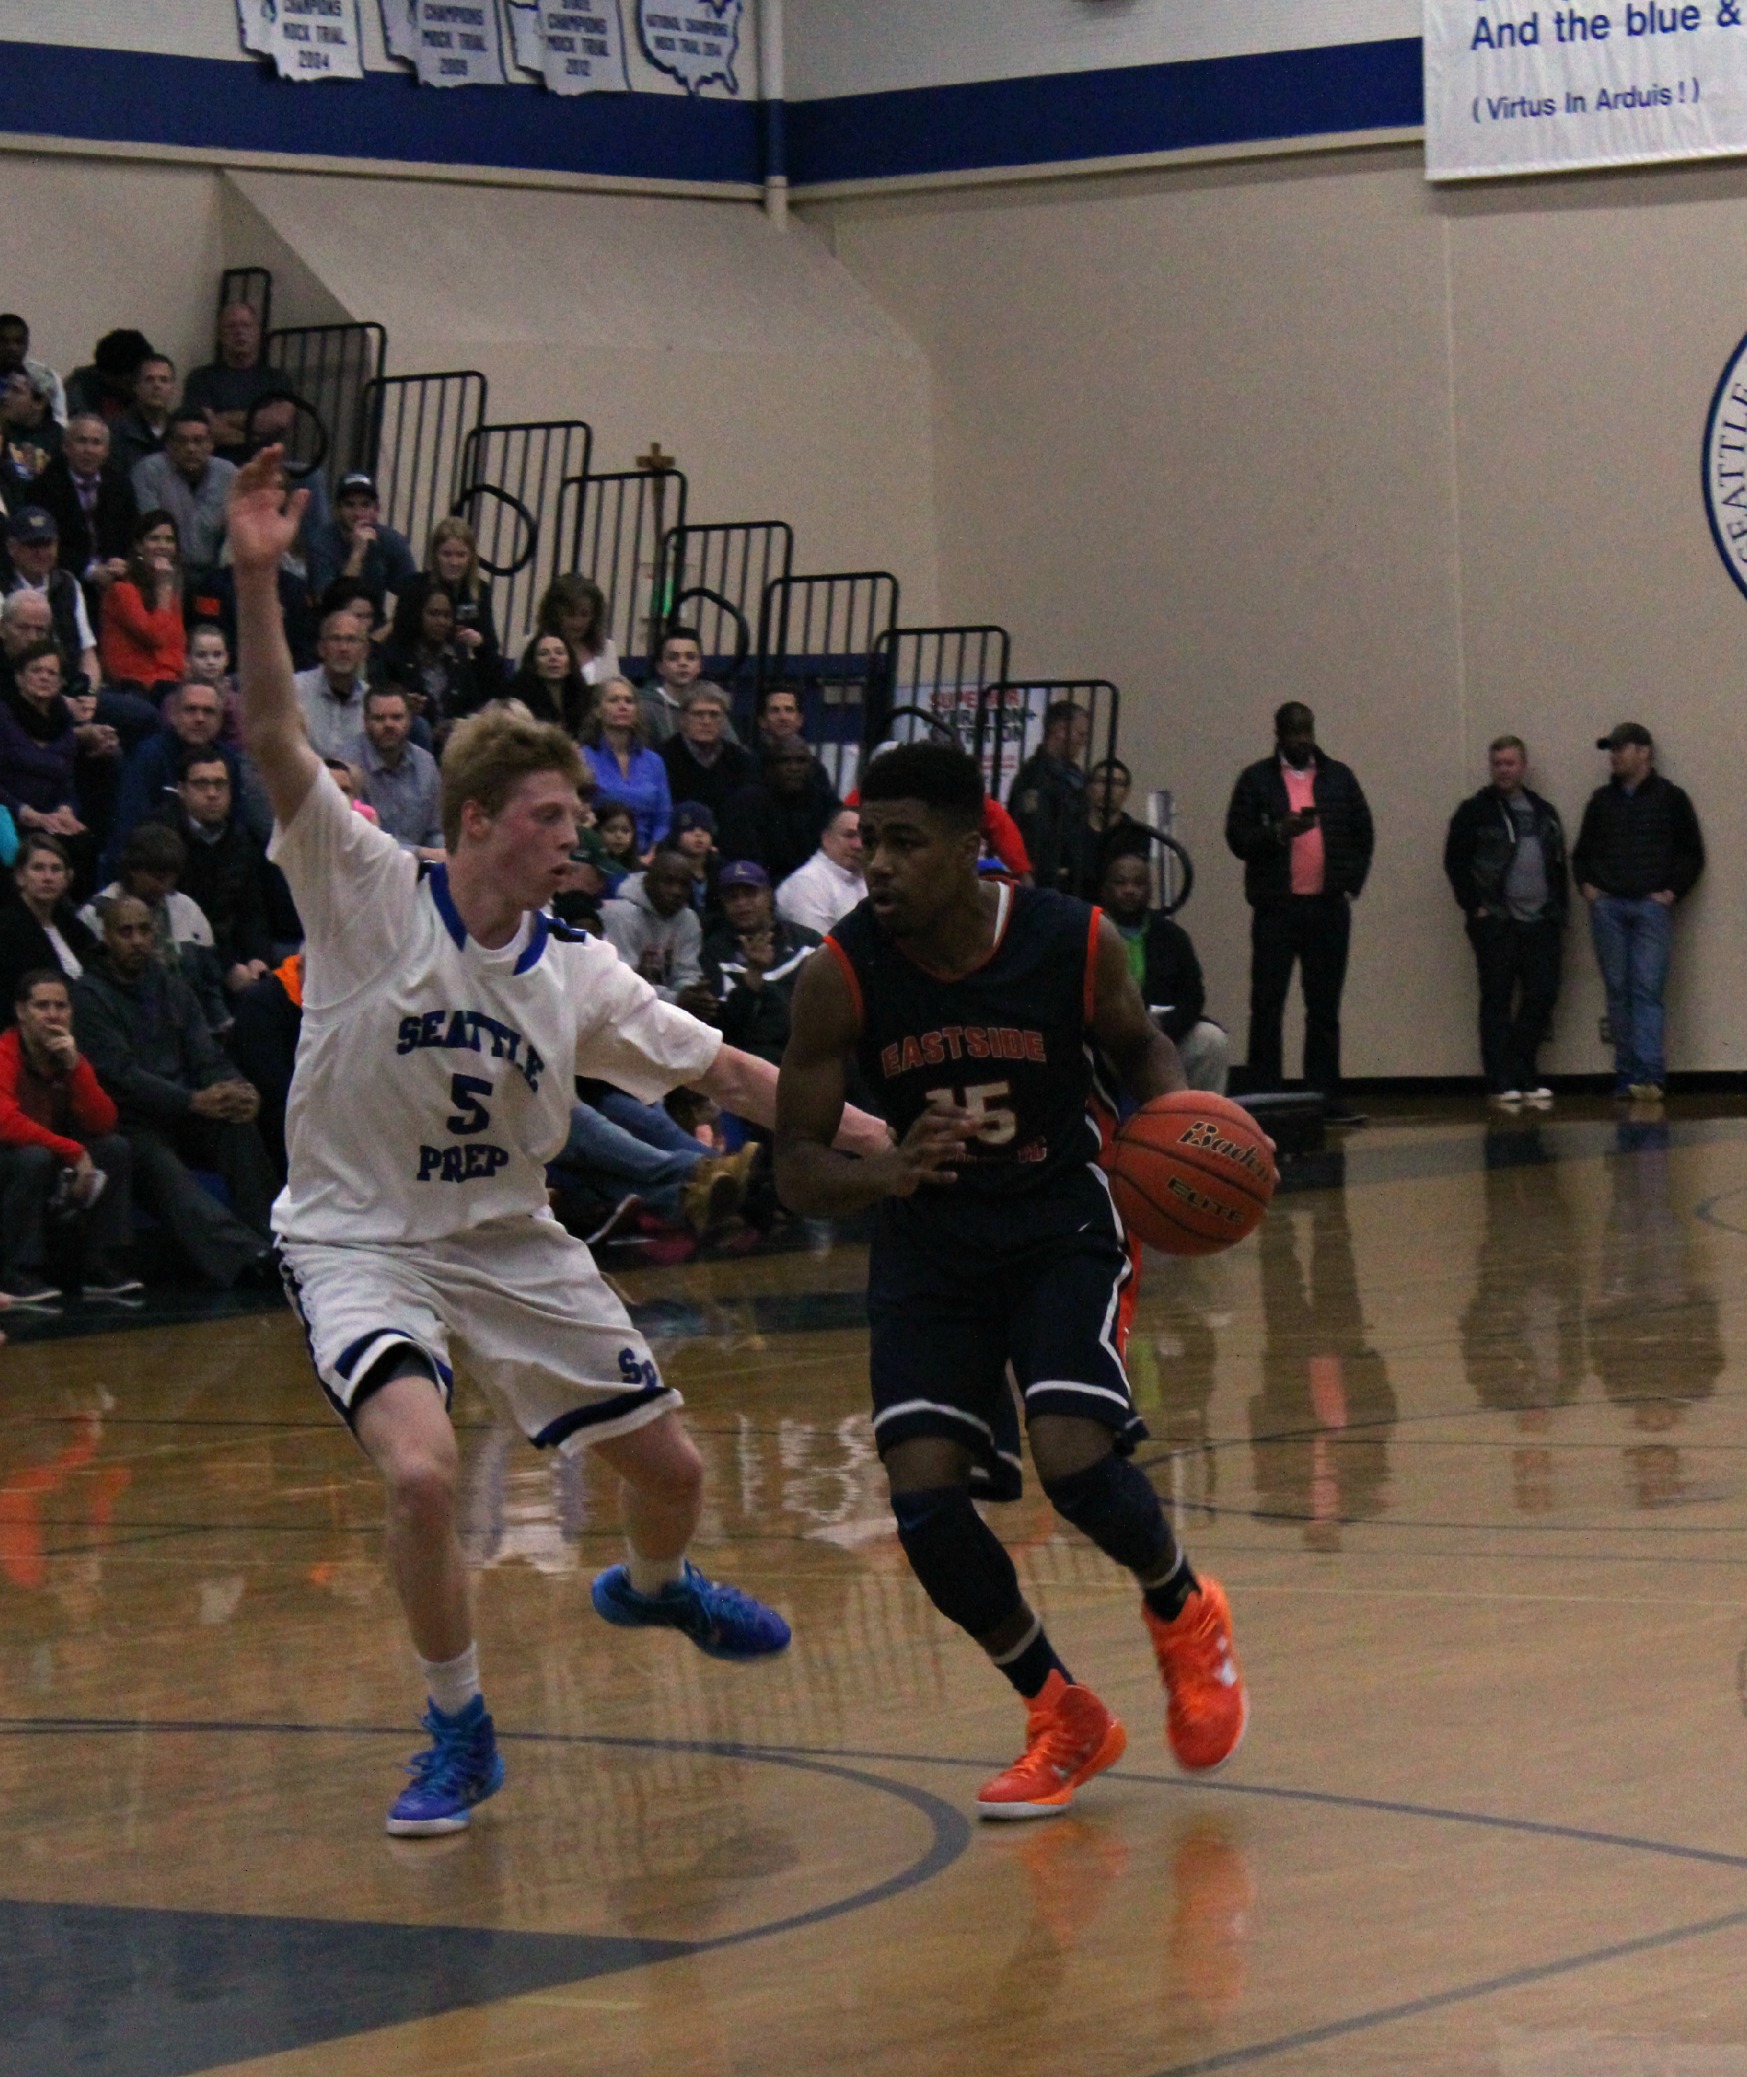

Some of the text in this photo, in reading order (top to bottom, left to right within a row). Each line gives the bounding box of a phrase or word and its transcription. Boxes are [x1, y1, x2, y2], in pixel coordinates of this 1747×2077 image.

[1471, 0, 1742, 51] And the blue &
[1565, 92, 1586, 114] In
[396, 1010, 546, 1093] SEATTLE
[881, 1026, 1047, 1078] EASTSIDE
[446, 1072, 493, 1135] 5
[416, 1143, 509, 1183] PREP
[1167, 1174, 1248, 1223] ELITE
